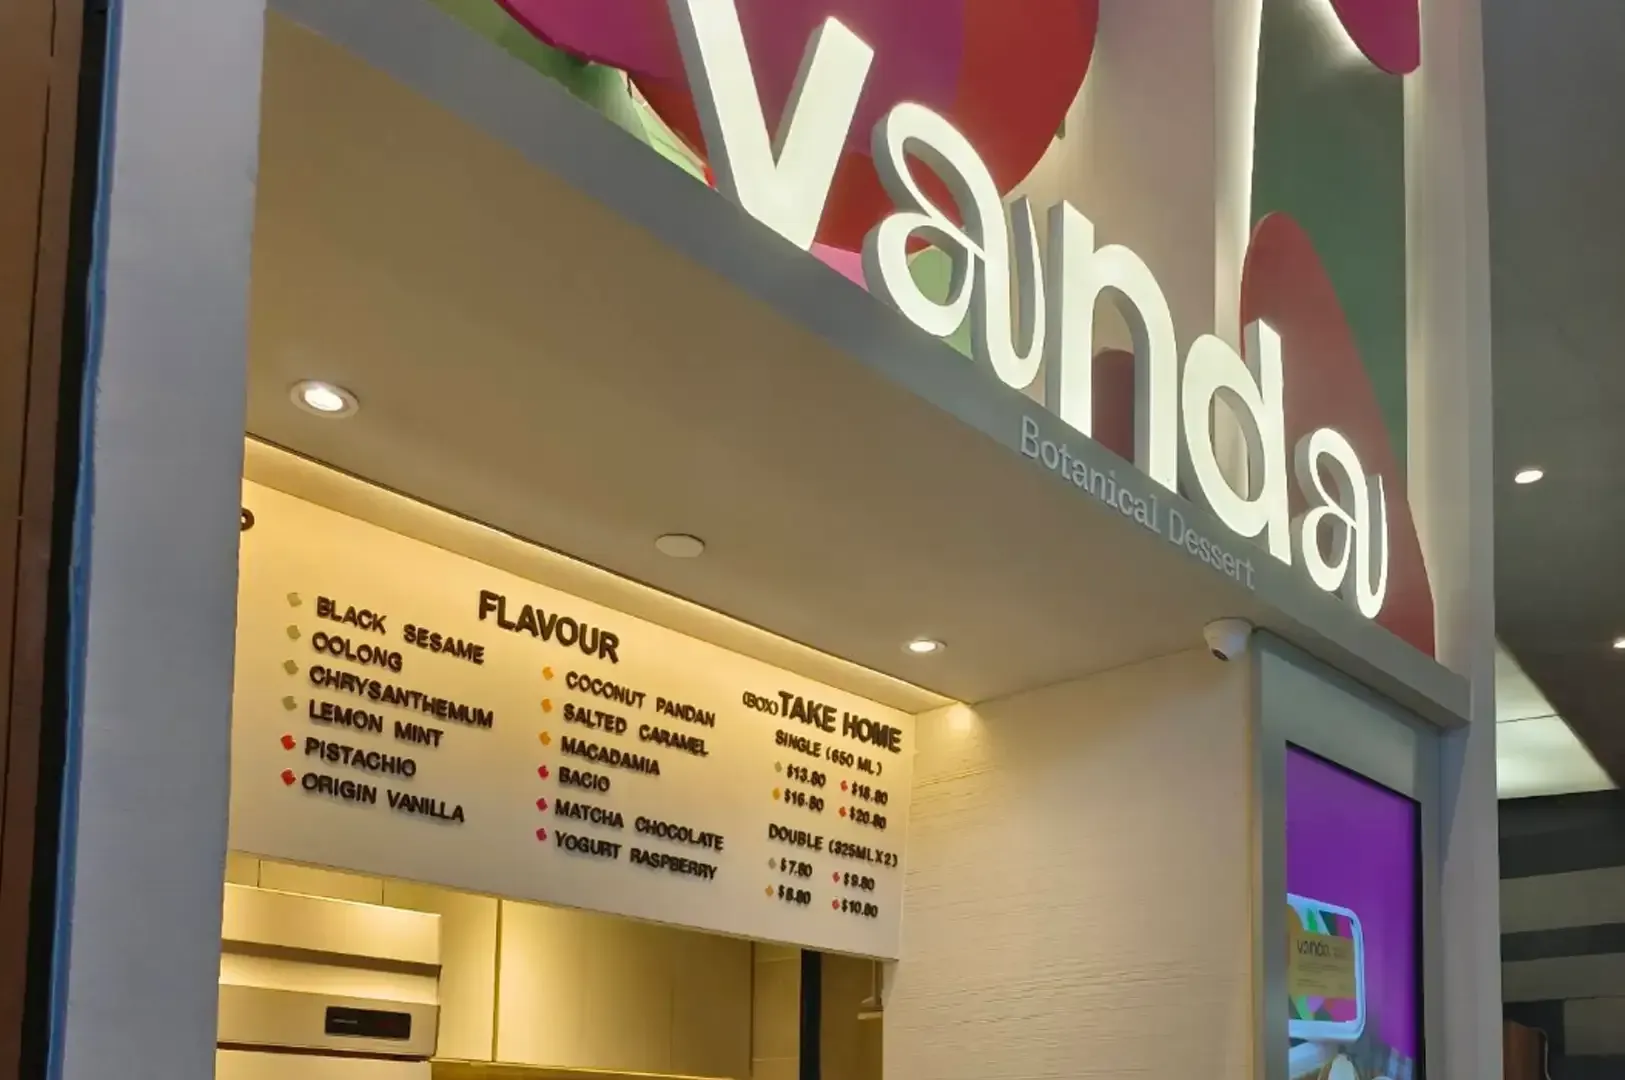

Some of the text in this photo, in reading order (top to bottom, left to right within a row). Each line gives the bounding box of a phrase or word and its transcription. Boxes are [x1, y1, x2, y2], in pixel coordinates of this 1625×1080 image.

[670, 0, 1388, 619] vanda
[1020, 415, 1255, 590] Botanical Dessert
[312, 631, 403, 673] OOLONG
[316, 596, 485, 665] BLACK SESAME
[478, 589, 619, 664] FLAVOUR
[309, 665, 494, 728] CHRYSANTHEMUM
[565, 671, 716, 728] COCONUT PANDAN
[742, 690, 902, 753] (BOX) TAKE HOME
[309, 699, 444, 747] LEMON MINT
[563, 703, 709, 756] SALTED CARAMEL
[775, 729, 822, 757] SINGLE
[304, 737, 417, 778] PISTACHIO
[559, 766, 610, 792] BACIO
[561, 736, 660, 775] MACADAMIA
[301, 773, 465, 822] ORIGIN VANILLA
[555, 799, 724, 851] MATCHA CHOCOLATE
[768, 823, 824, 850] DOUBLE
[555, 830, 717, 880] YOGURT RASPBERRY
